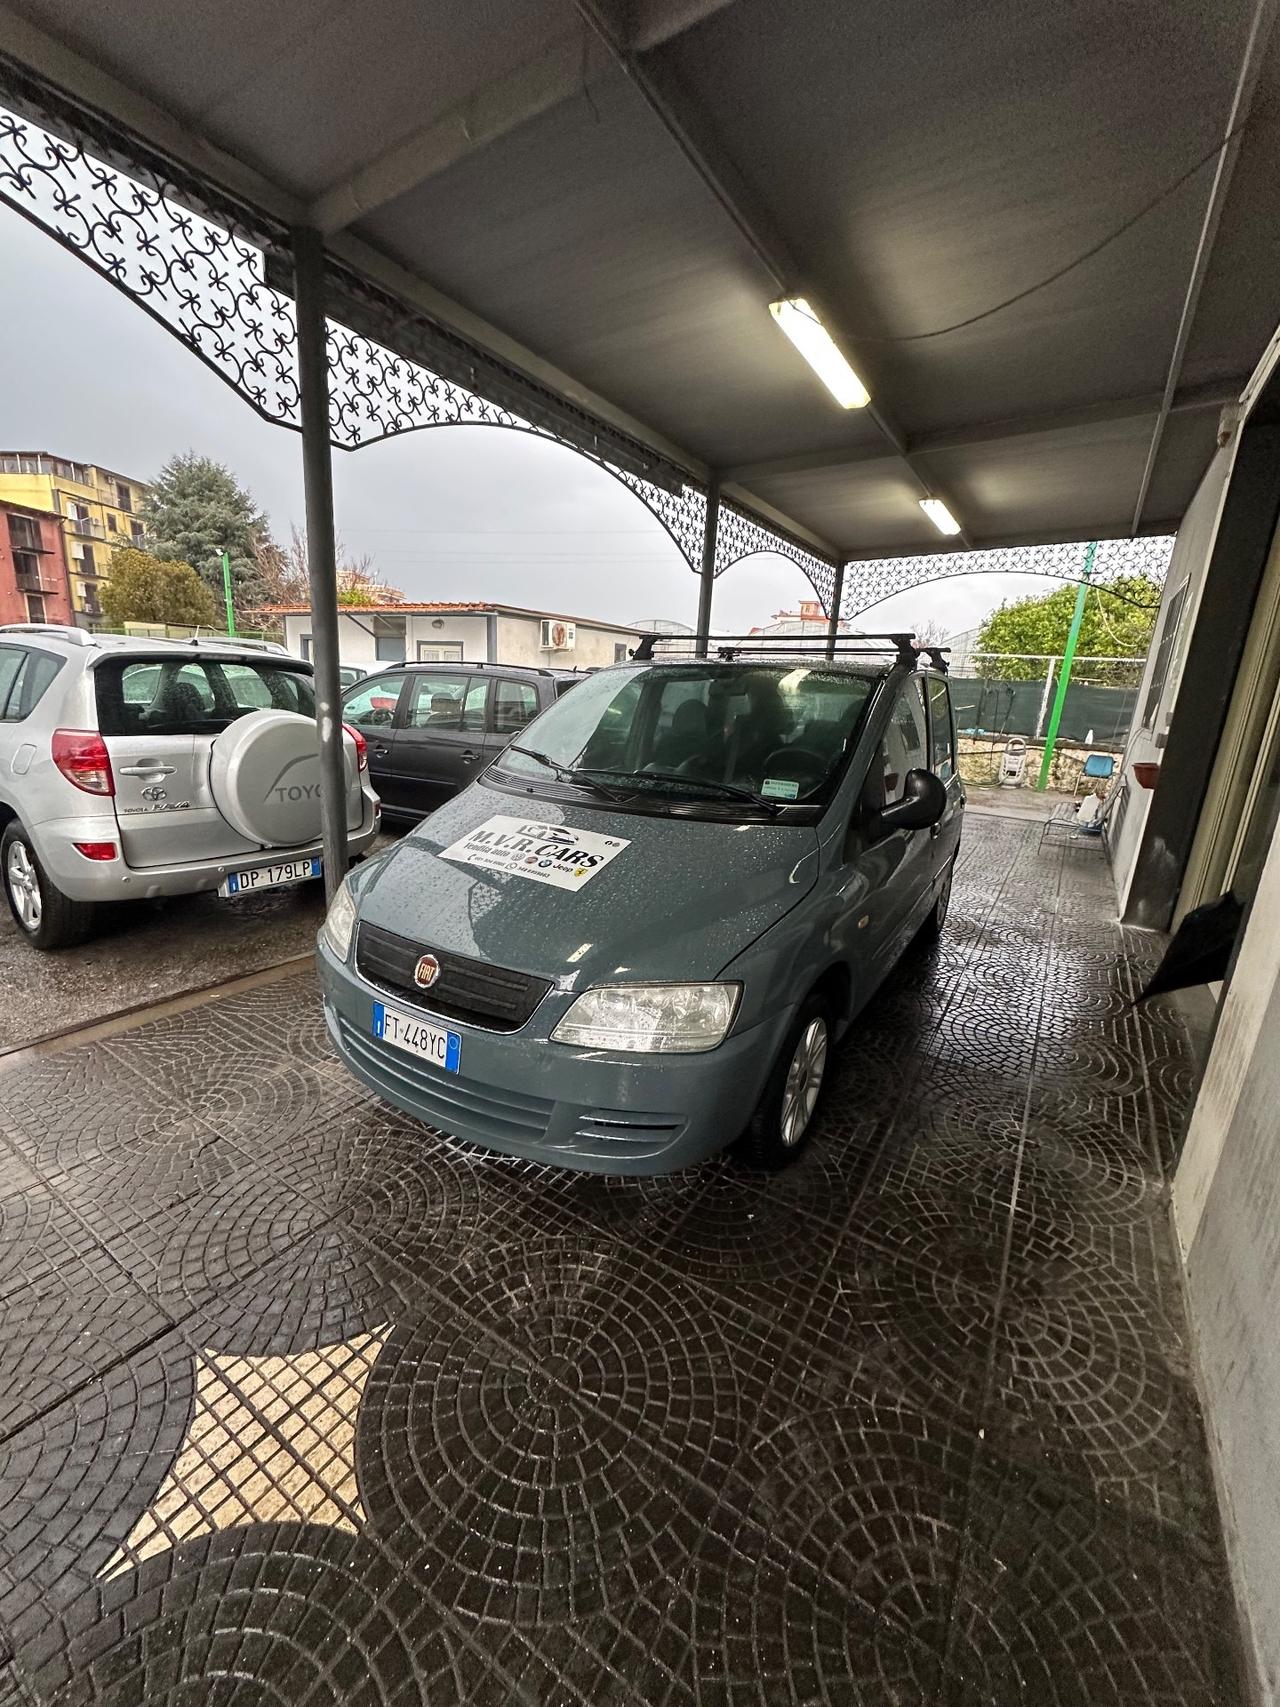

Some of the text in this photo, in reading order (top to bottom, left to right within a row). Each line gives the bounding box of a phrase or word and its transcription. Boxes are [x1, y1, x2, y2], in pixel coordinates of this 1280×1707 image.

[535, 844, 604, 868] CARS
[553, 863, 574, 873] Jeep
[240, 871, 259, 889] DP
[267, 861, 310, 883] 179LP
[419, 963, 435, 981] FIAT
[385, 1014, 399, 1039] FT
[403, 1023, 445, 1059] 448YC
